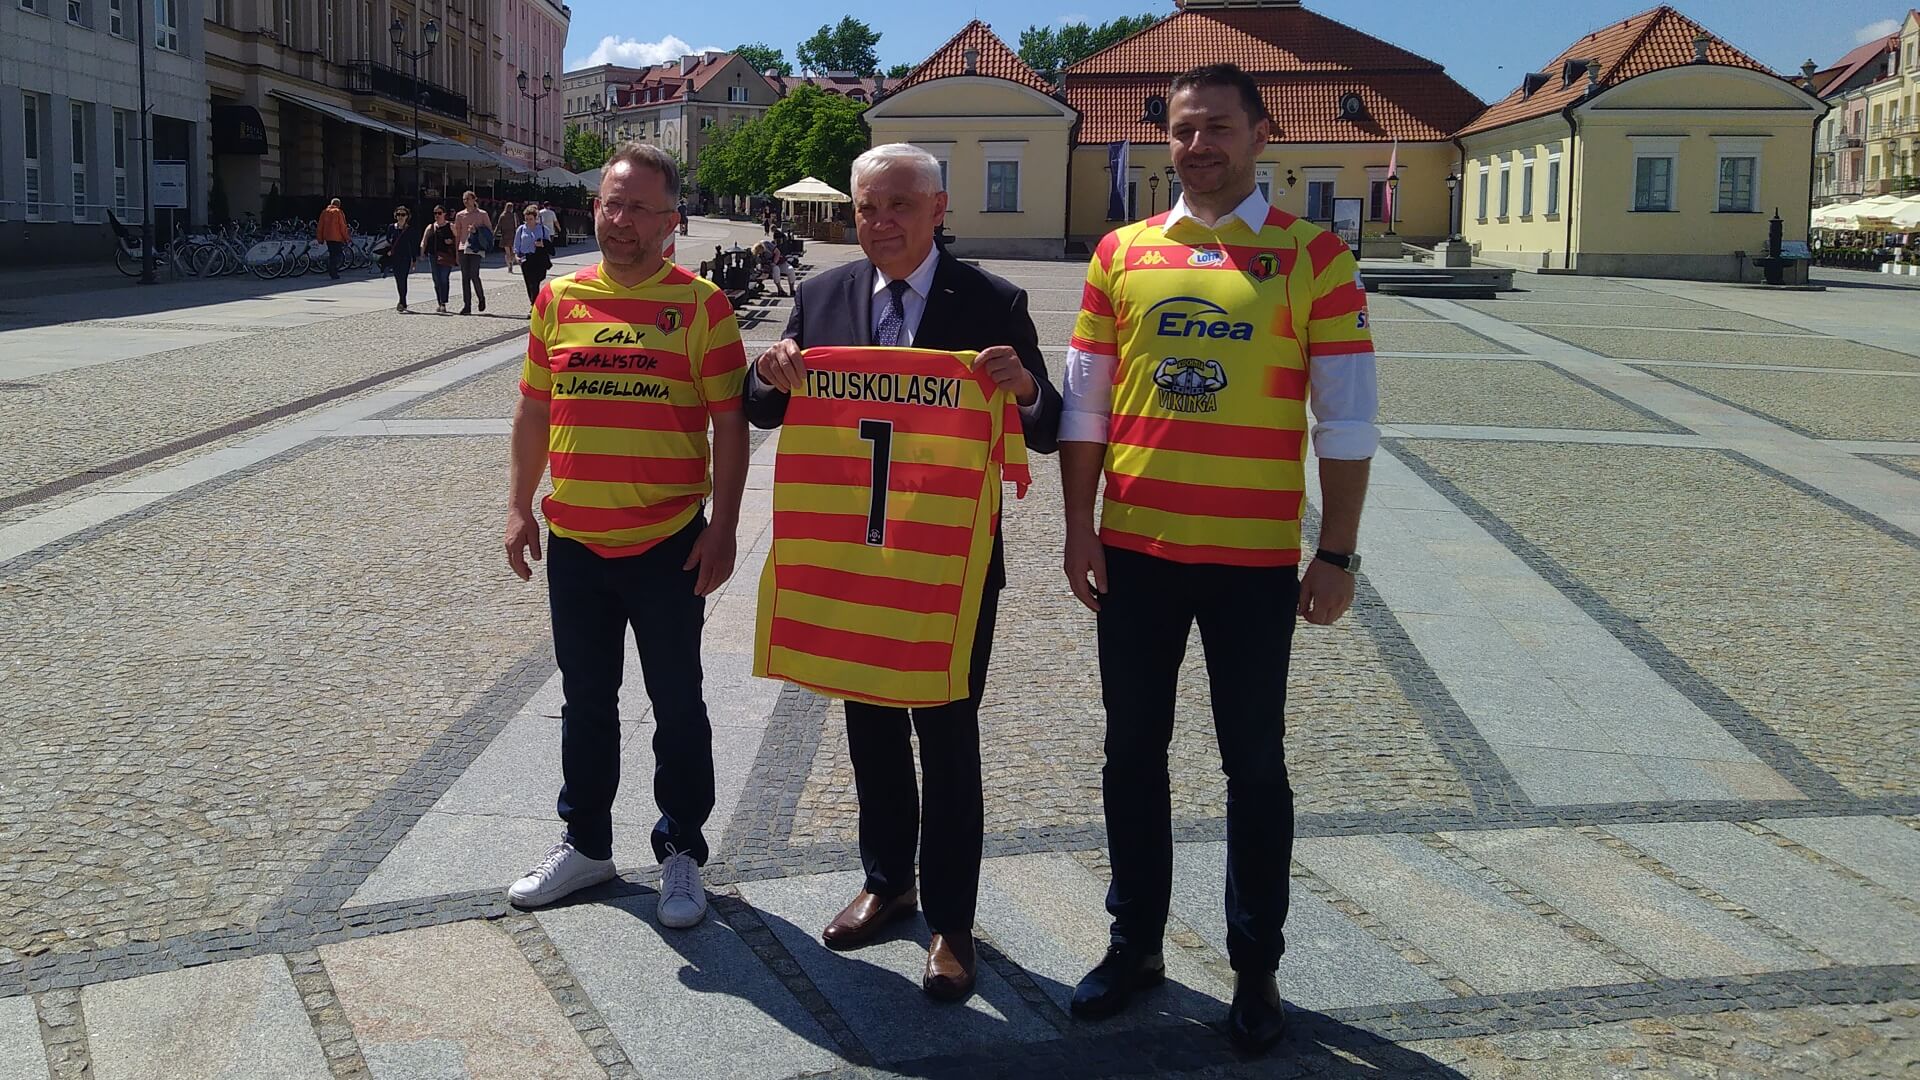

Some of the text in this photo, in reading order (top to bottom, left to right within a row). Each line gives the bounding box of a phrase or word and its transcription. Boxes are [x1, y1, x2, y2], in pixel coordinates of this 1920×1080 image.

[593, 327, 646, 345] CAŁY
[1157, 312, 1254, 341] Enea
[806, 368, 961, 409] TRUSKOLASKI
[1158, 389, 1217, 413] VIKINGA
[858, 418, 894, 547] 1
